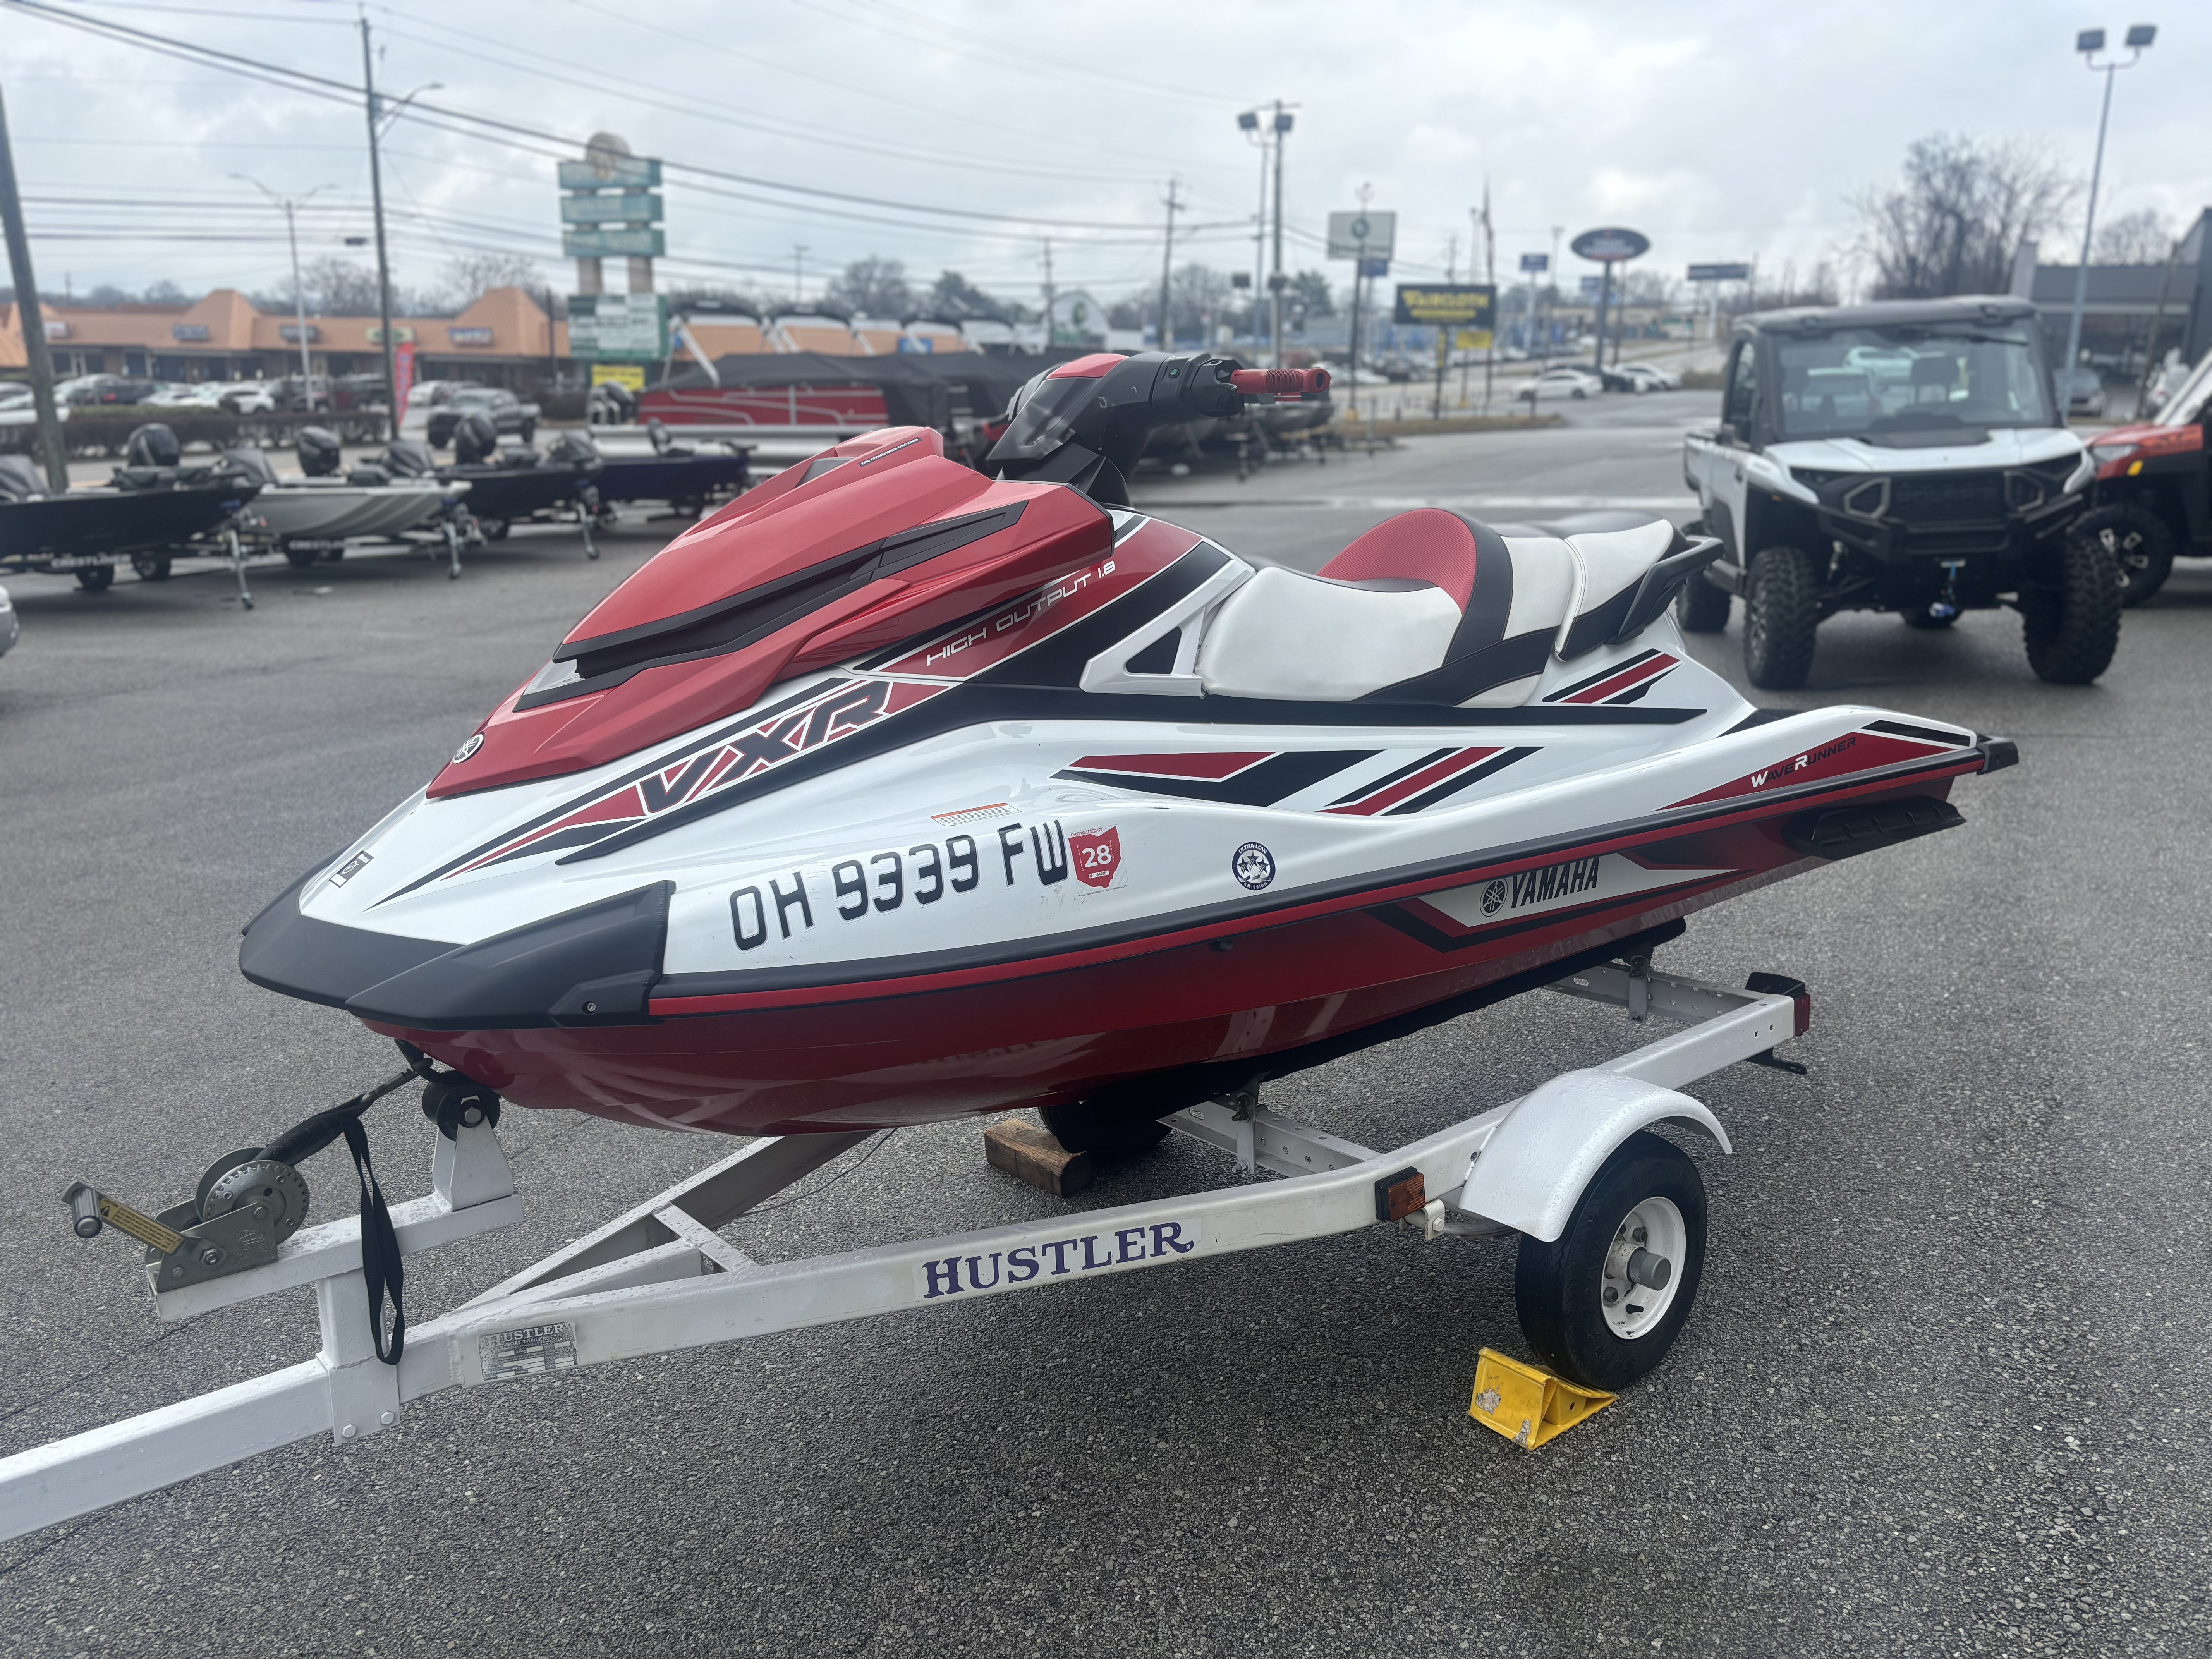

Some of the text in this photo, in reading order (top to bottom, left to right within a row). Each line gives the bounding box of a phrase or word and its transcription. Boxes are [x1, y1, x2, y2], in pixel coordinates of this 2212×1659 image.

[926, 560, 1116, 666] HIGH OUTPUT 1.8
[638, 680, 891, 814] VXR
[1080, 827, 1103, 835] WATERCRAFT
[1082, 845, 1112, 868] 28
[730, 819, 1069, 952] OH 9339 FW
[1511, 857, 1600, 909] YAMAHA
[921, 1222, 1194, 1299] HUSTLER
[487, 1324, 564, 1348] HUSTLER
